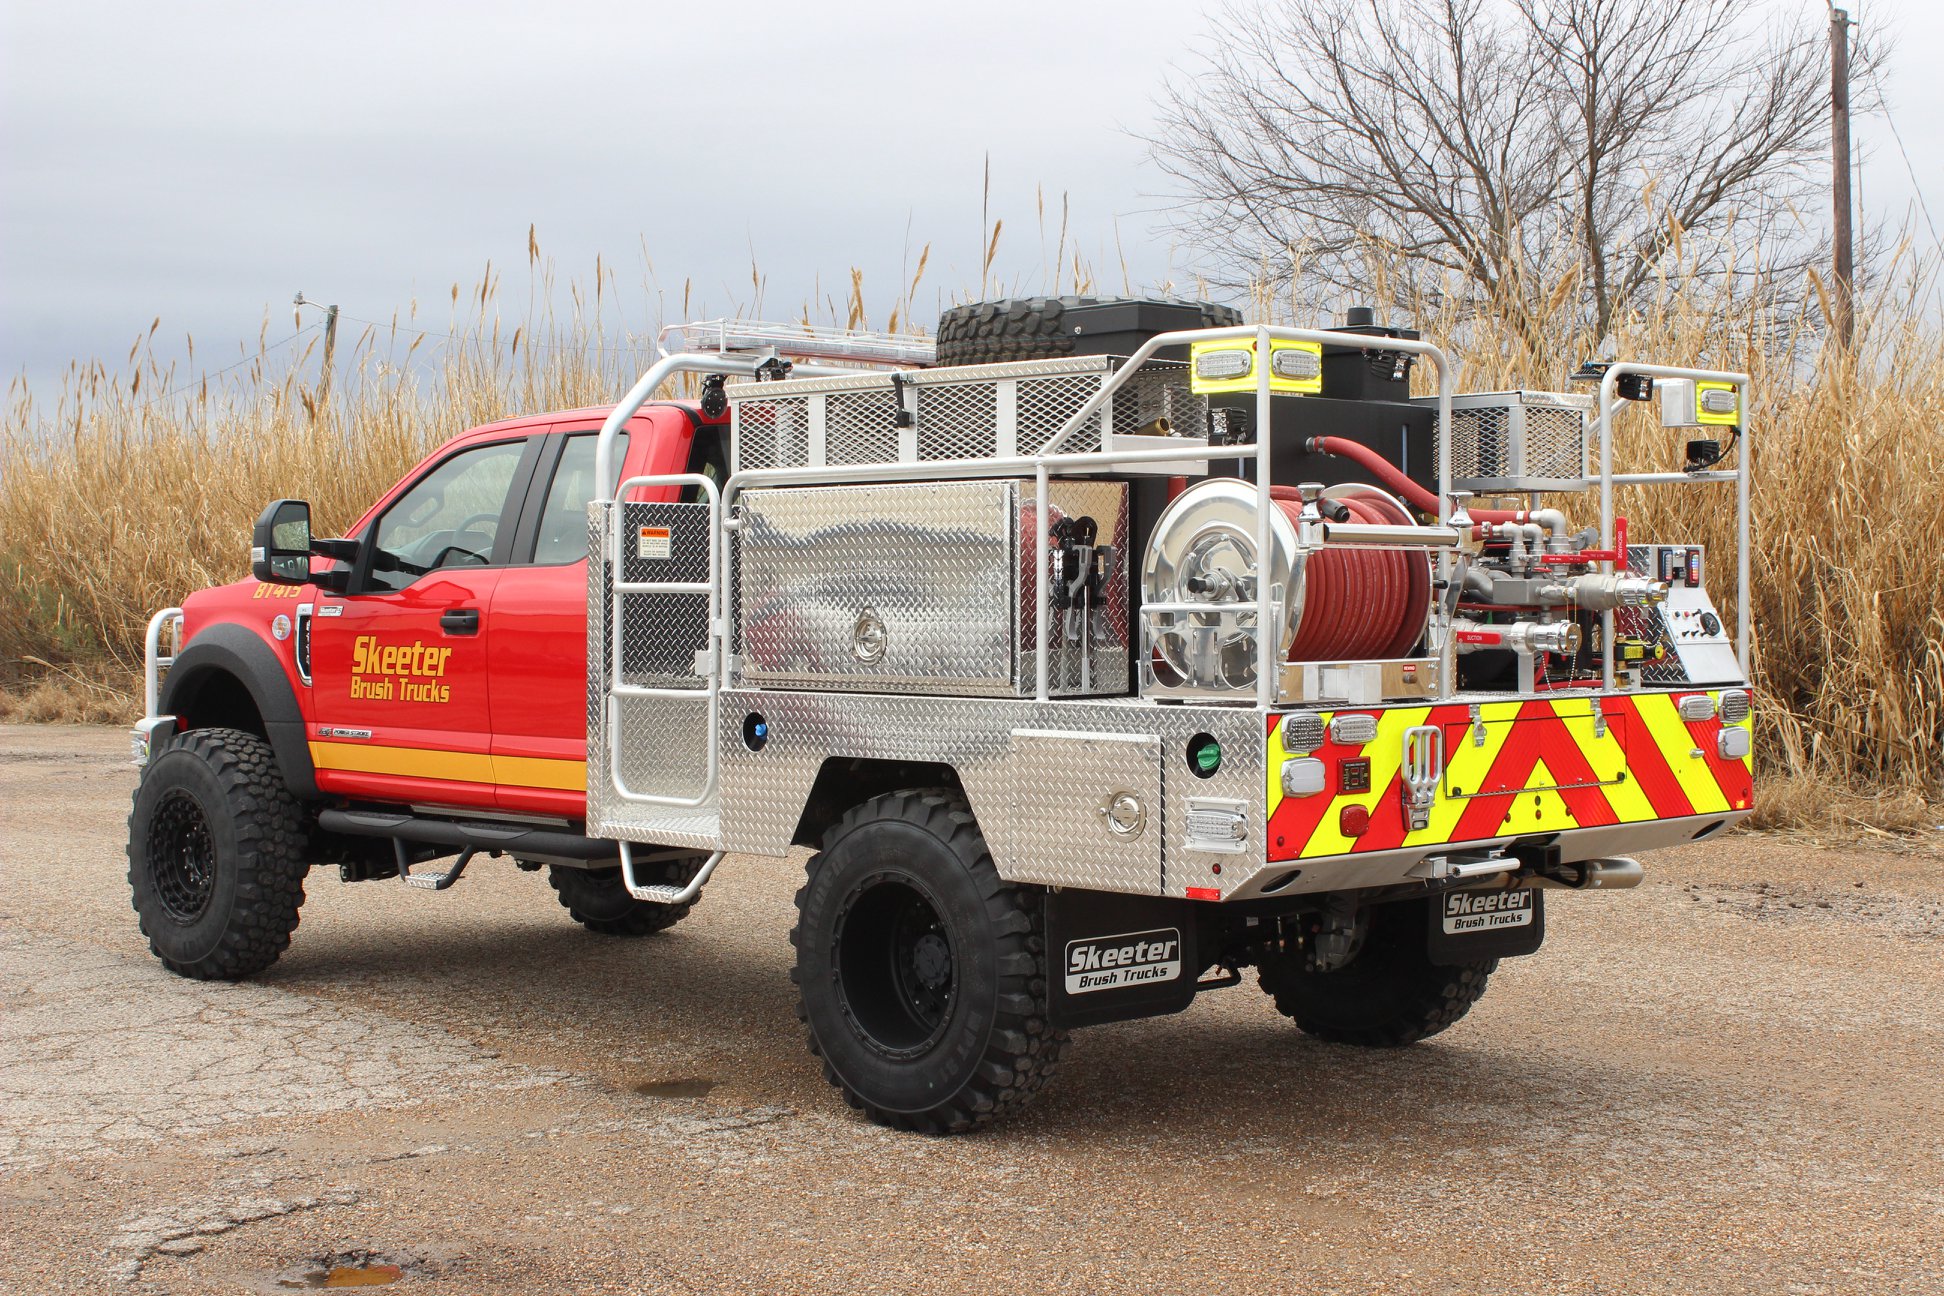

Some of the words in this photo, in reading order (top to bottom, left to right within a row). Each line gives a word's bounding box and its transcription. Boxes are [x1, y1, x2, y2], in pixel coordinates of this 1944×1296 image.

[351, 635, 452, 677] Skeeter
[350, 675, 393, 701] Brush
[399, 677, 450, 703] Trucks
[1447, 890, 1529, 916] Skeeter
[1454, 916, 1485, 930] Brush
[1489, 912, 1522, 926] Trucks
[1069, 940, 1177, 973] Skeeter
[1078, 972, 1117, 989] Brush
[1124, 965, 1168, 982] Trucks
